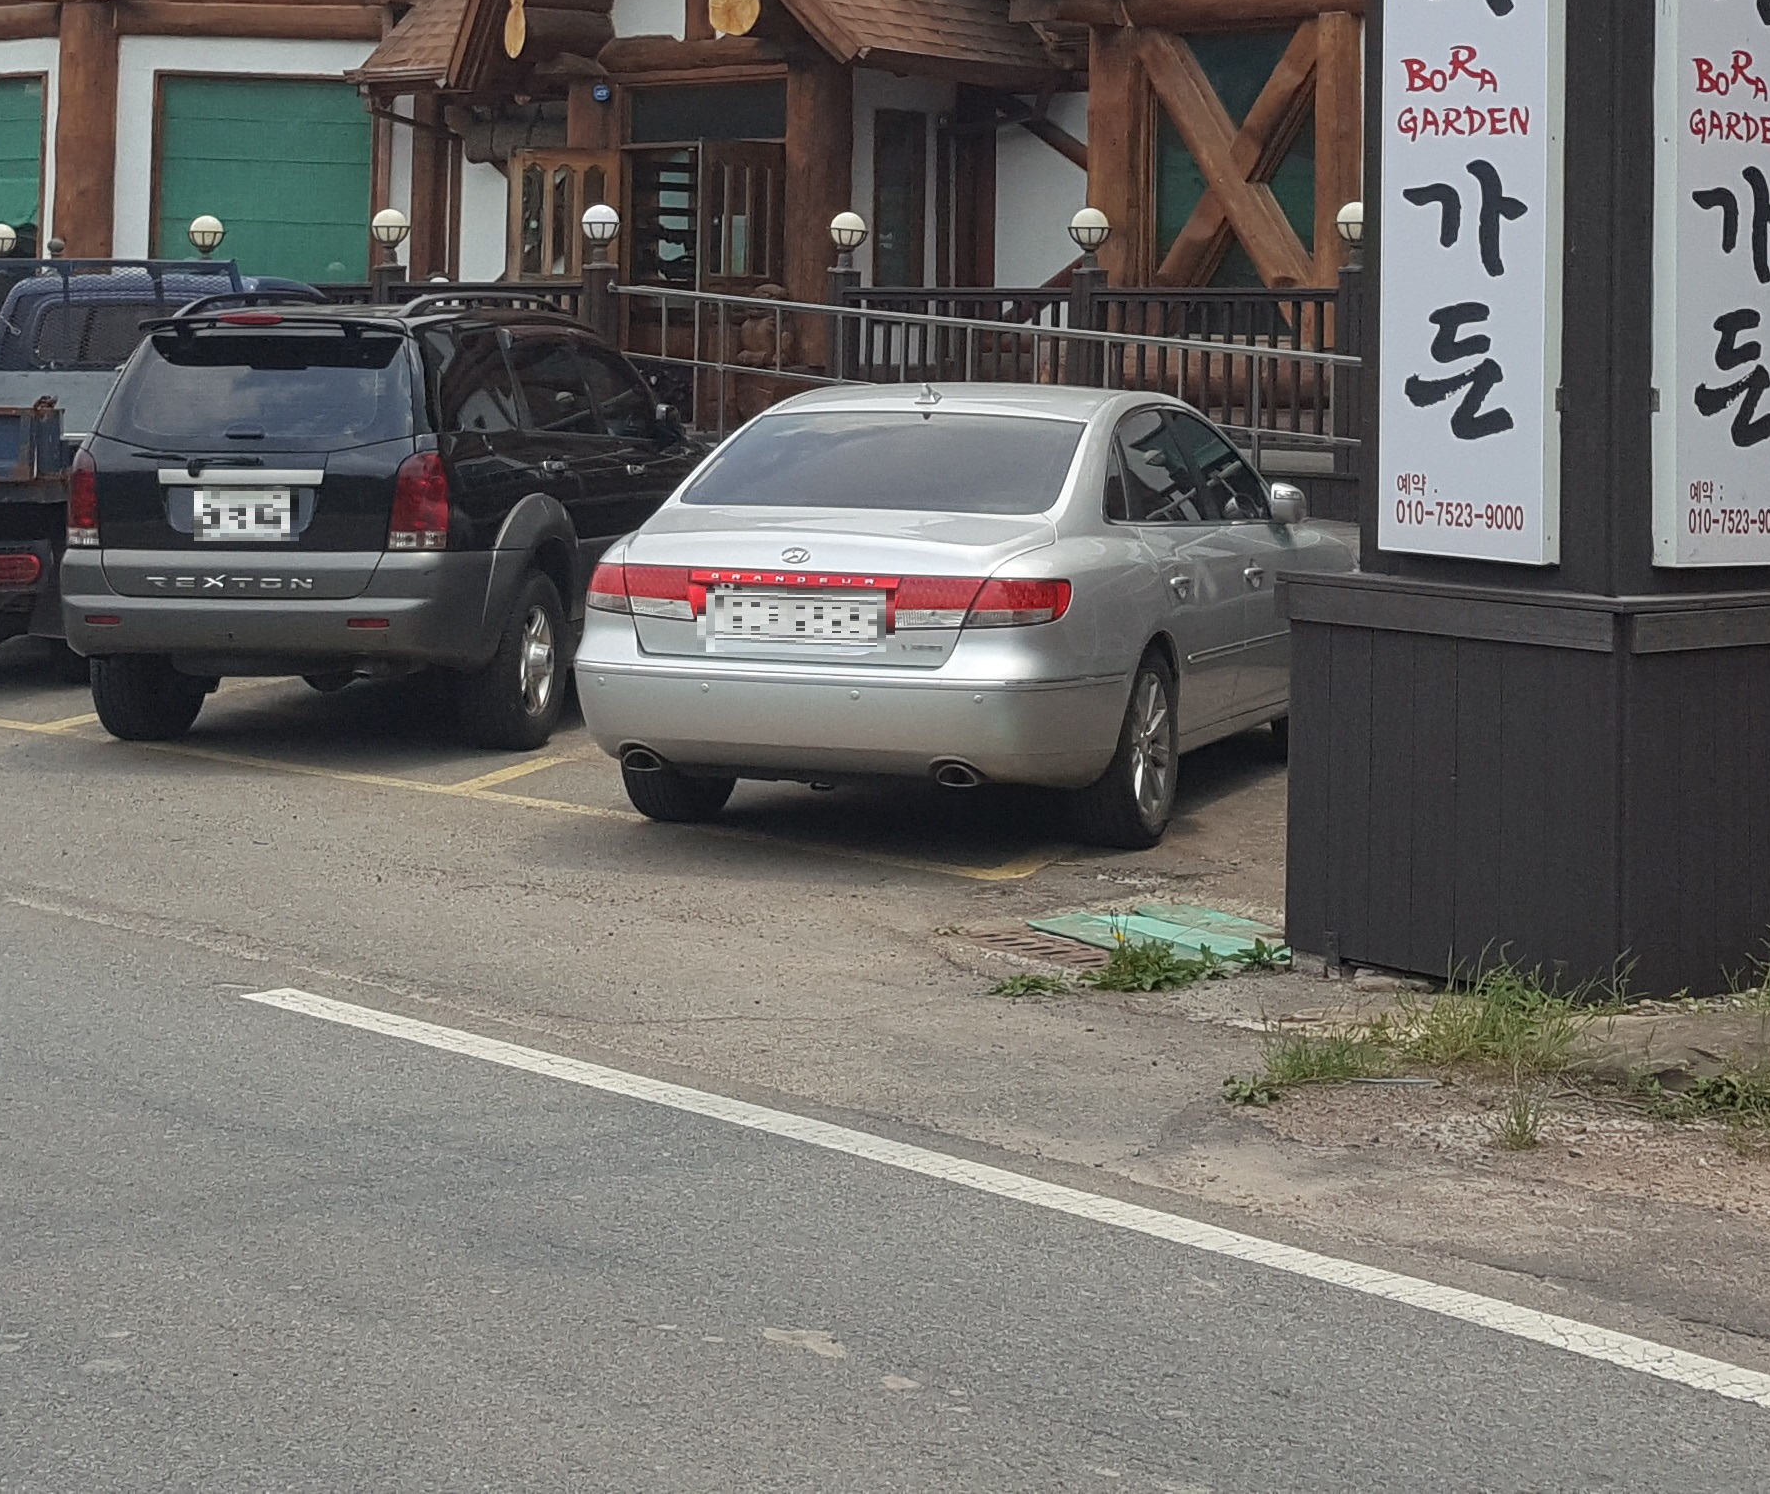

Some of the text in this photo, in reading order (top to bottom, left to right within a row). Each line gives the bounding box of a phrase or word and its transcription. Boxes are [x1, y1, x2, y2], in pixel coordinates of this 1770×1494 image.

[1400, 45, 1498, 93] BORA
[1694, 49, 1769, 101] BORA
[1397, 105, 1530, 142] GARDEN
[1402, 159, 1529, 440] 가든
[1396, 473, 1427, 497] 예약
[1689, 480, 1714, 504] 예약
[1396, 499, 1524, 531] 010-7523-9000
[145, 573, 313, 589] REXTON
[710, 572, 876, 586] GRANDEUR
